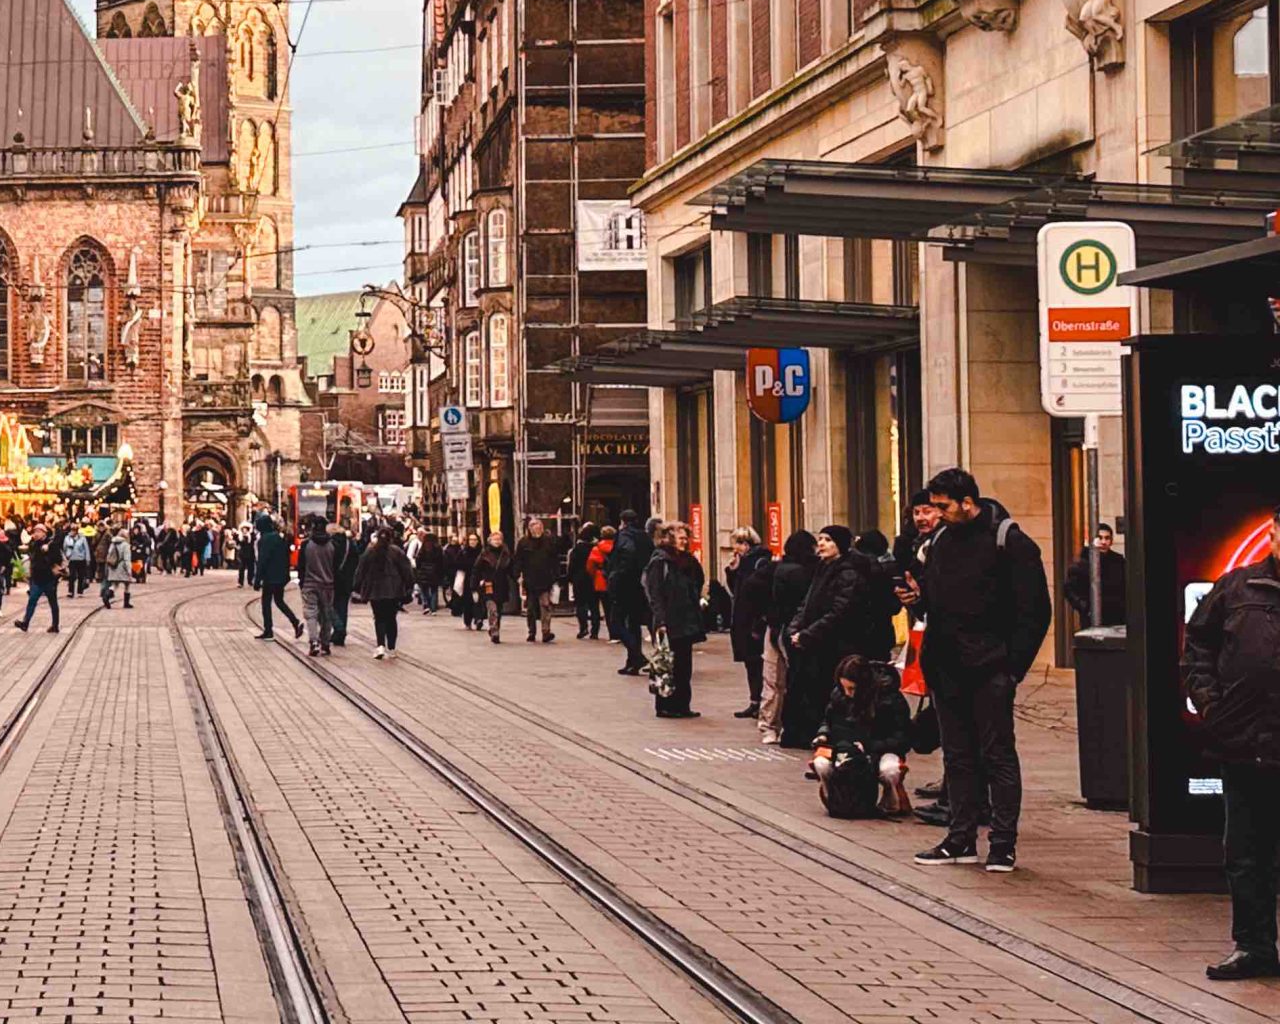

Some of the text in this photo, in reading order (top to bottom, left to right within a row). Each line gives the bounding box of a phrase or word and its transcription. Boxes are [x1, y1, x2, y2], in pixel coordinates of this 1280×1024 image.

[1076, 252, 1101, 283] H
[1052, 320, 1120, 332] Obernstraße
[755, 365, 804, 396] P&C
[1181, 384, 1280, 419] BLAC
